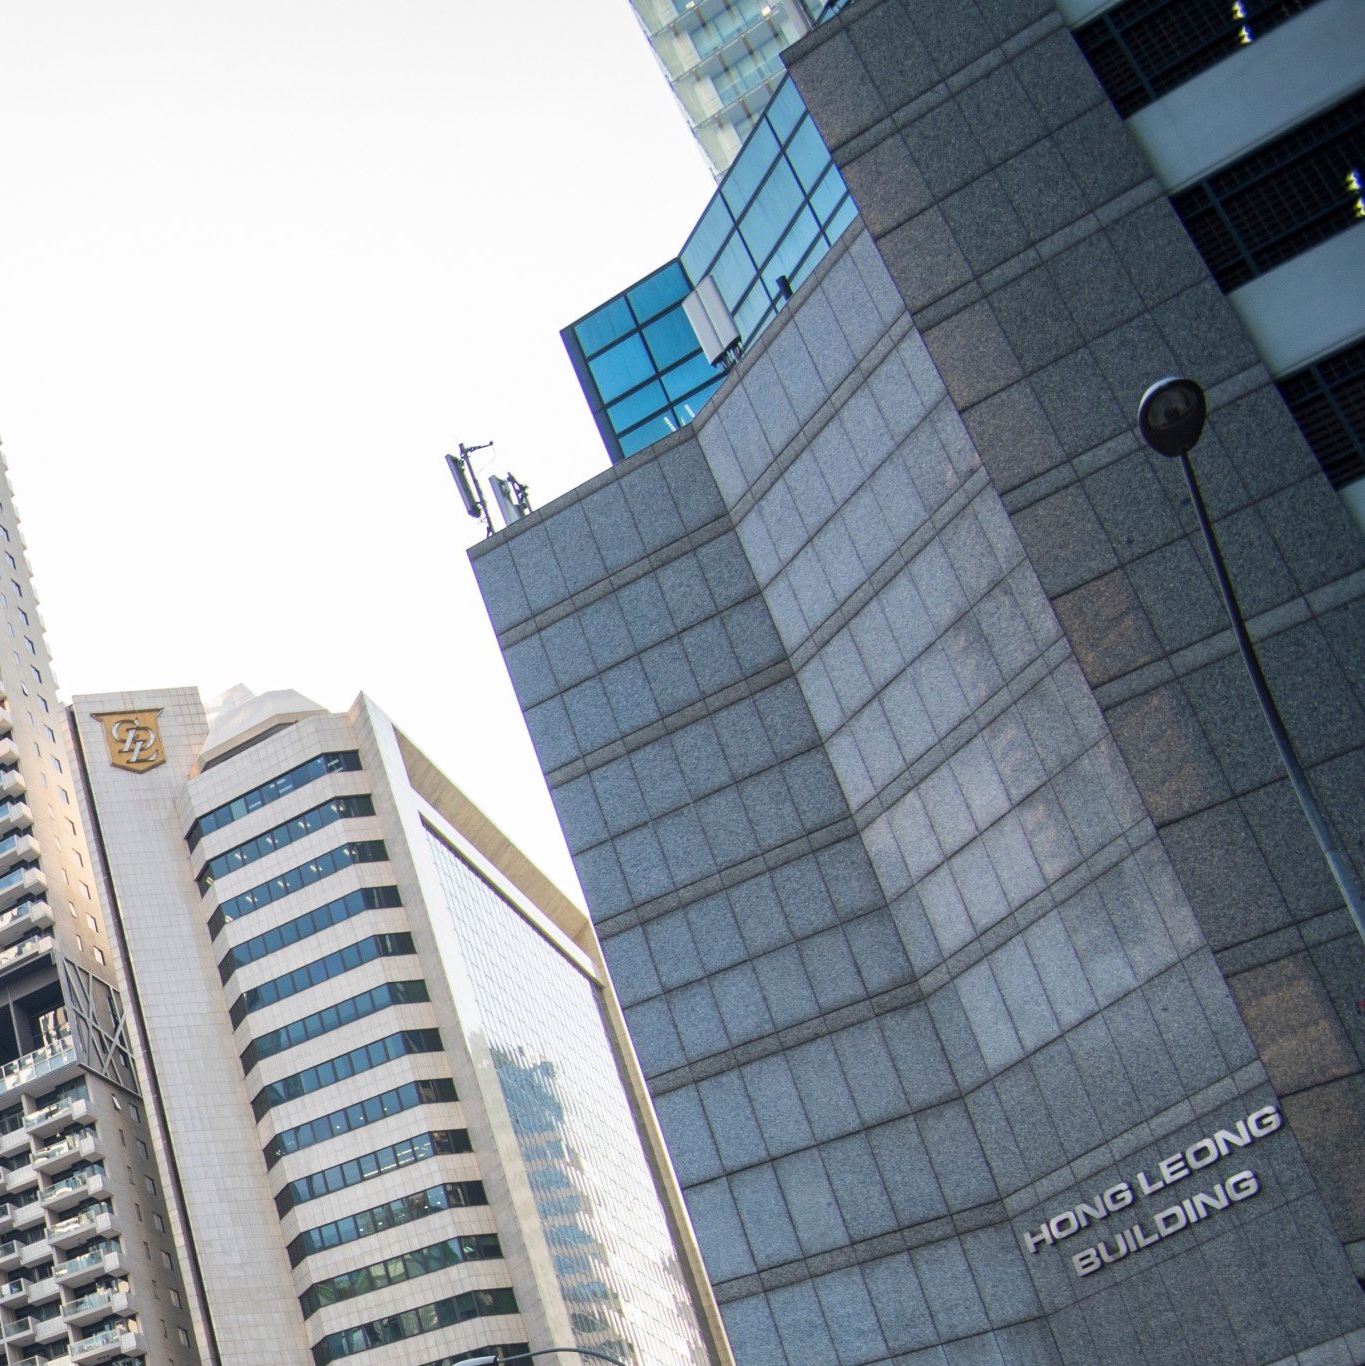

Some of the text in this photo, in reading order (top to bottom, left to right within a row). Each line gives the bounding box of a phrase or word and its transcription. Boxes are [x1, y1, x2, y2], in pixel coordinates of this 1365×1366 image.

[1023, 1105, 1283, 1254] HONG LEONG
[1071, 1169, 1260, 1277] BUILDING
